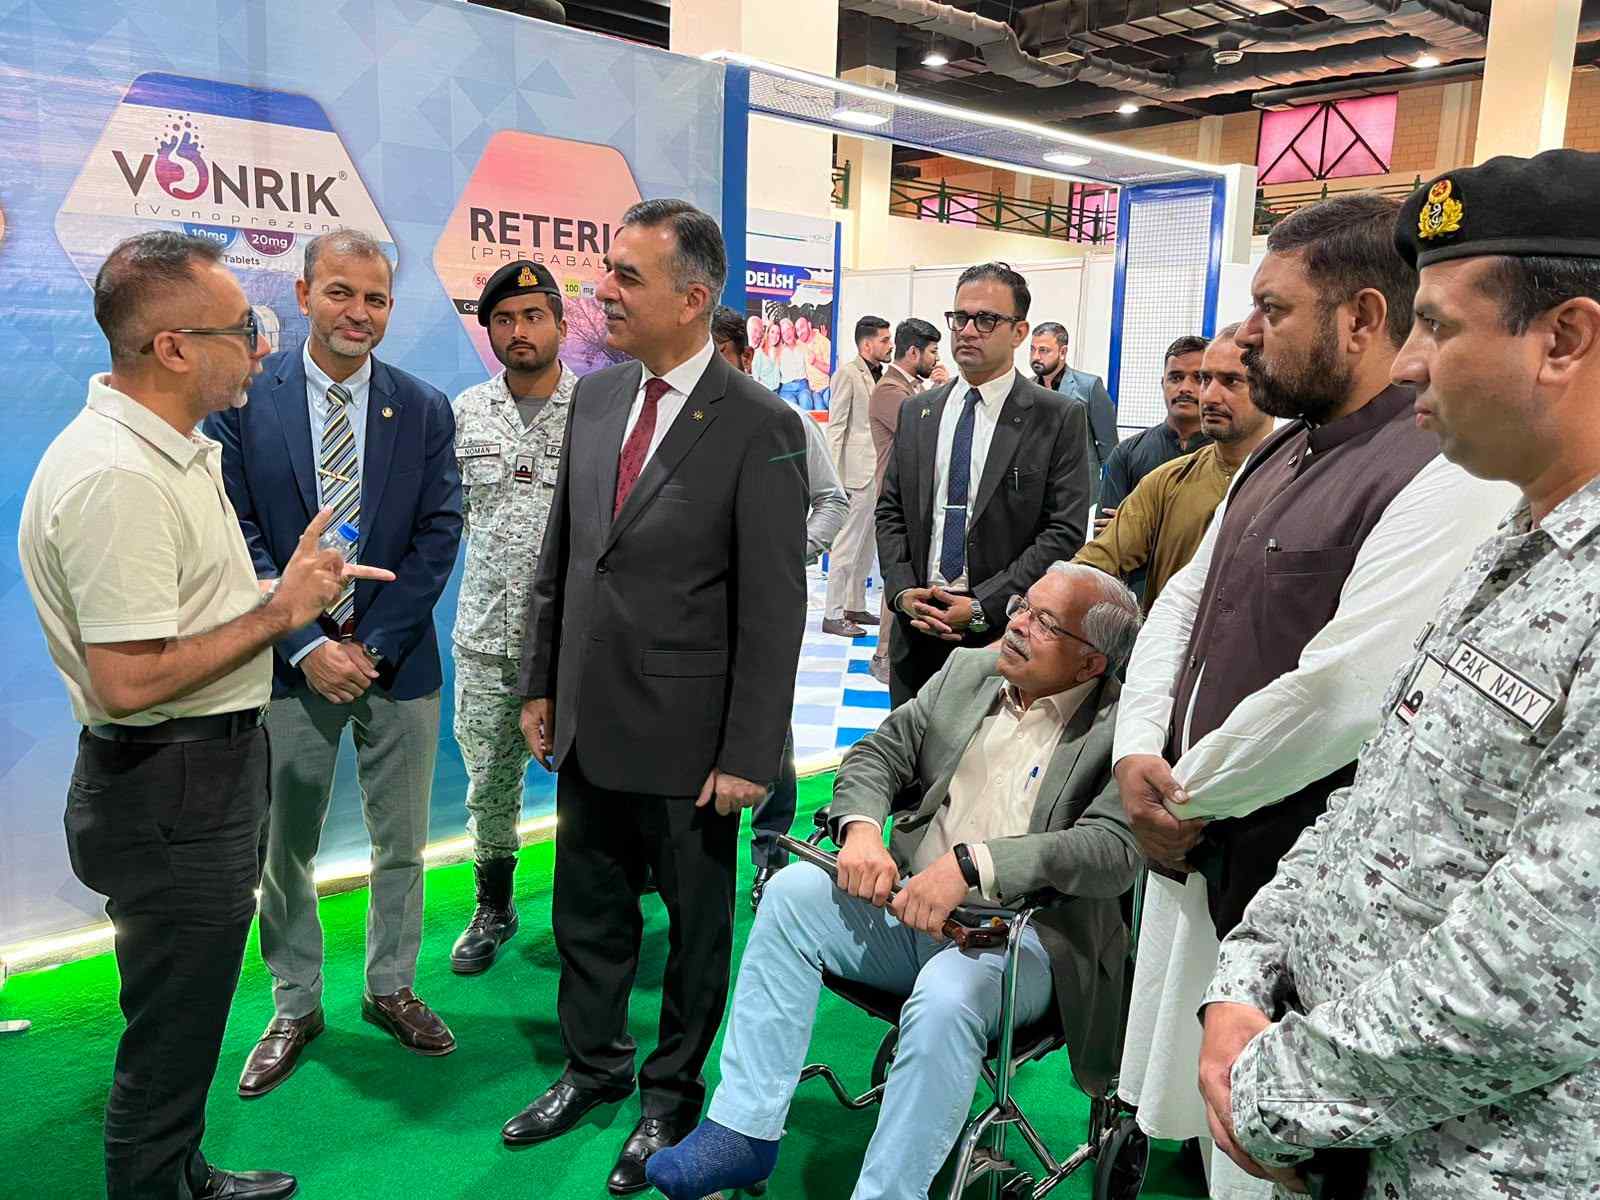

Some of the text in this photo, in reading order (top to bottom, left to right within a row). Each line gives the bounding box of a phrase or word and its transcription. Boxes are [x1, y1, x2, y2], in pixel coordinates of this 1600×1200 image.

[470, 207, 624, 254] RETERI
[251, 233, 288, 249] 20mg
[223, 254, 260, 265] Tablets
[565, 284, 579, 293] 100
[583, 287, 594, 296] mg
[464, 446, 490, 456] NOMAN
[1455, 650, 1541, 715] PAK NAVY
